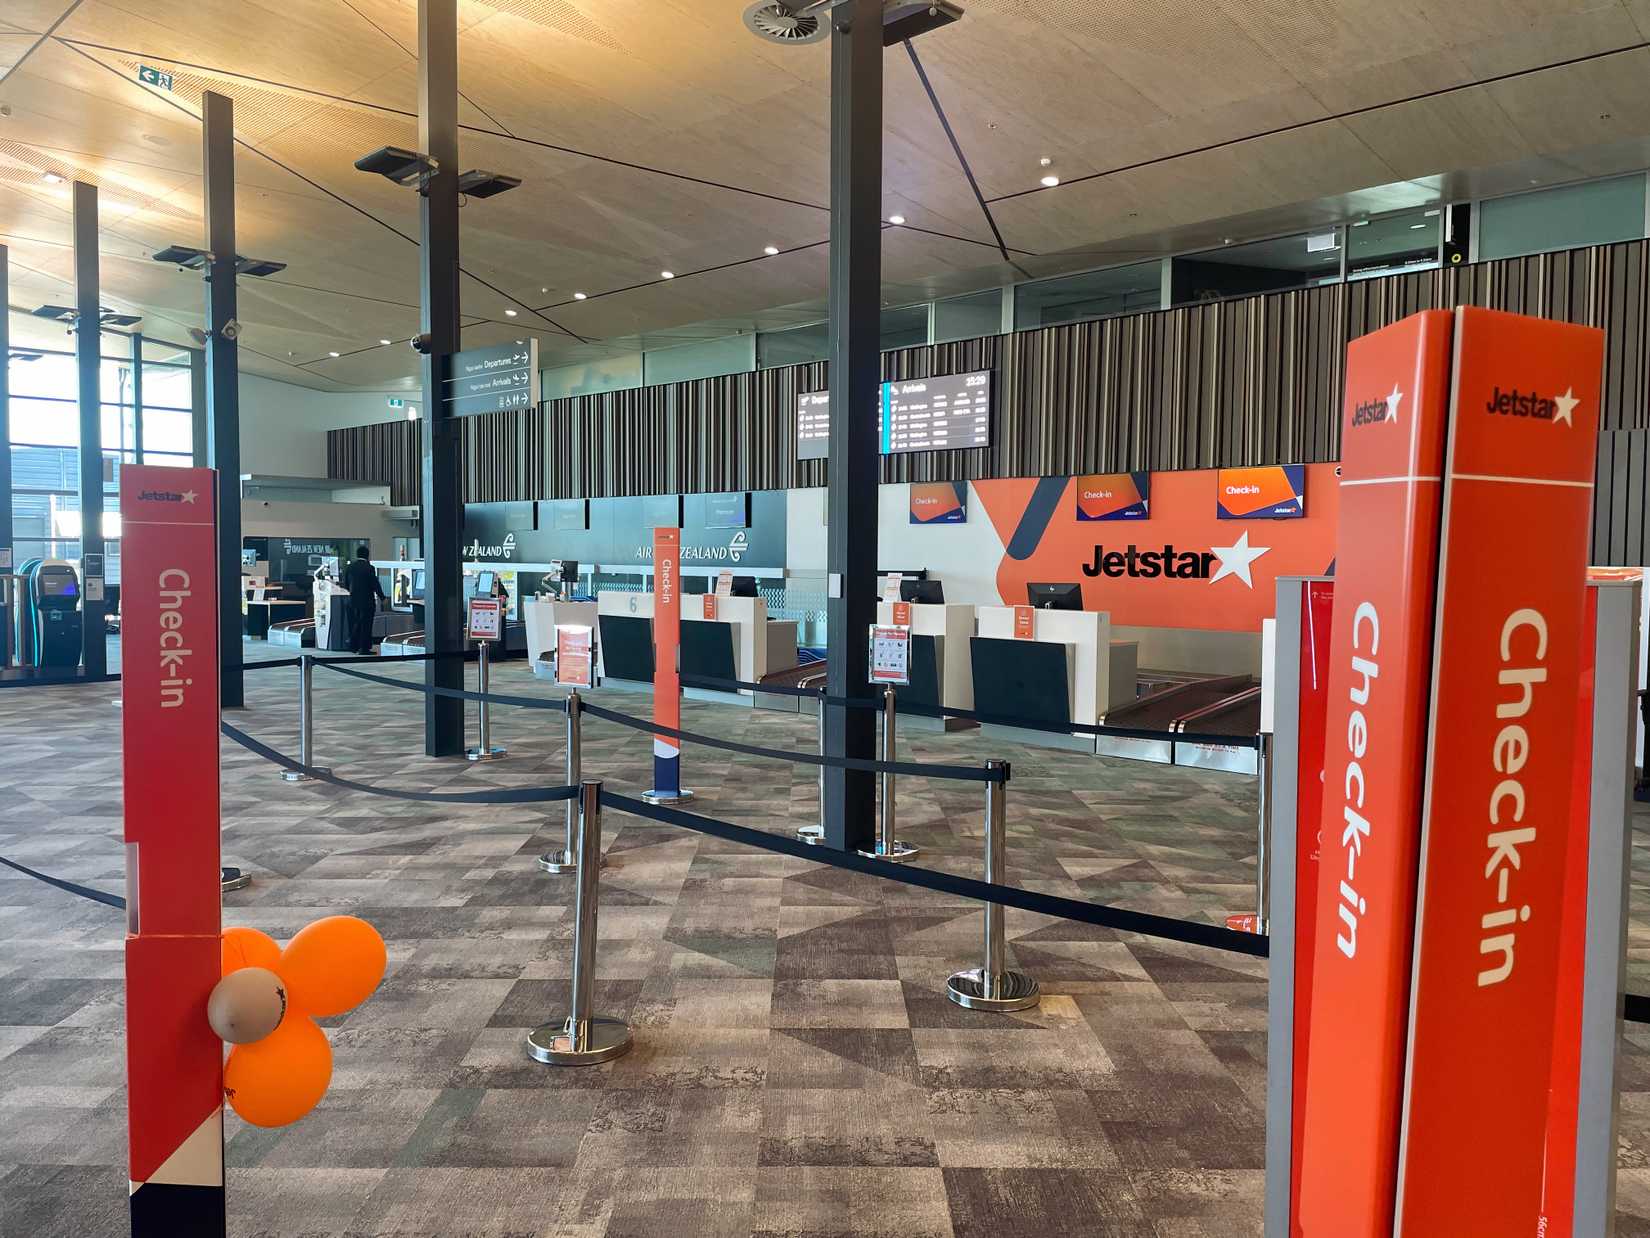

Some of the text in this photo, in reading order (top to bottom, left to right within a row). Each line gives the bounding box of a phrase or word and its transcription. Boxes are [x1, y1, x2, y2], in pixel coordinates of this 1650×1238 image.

[484, 358, 512, 369] Departures
[1351, 397, 1389, 427] Jetstar
[1487, 386, 1557, 420] Jetstar
[137, 490, 184, 502] Jetstar
[1084, 490, 1113, 499] Check-in
[1226, 485, 1260, 495] Check-in
[635, 546, 728, 559] AIR ZEALAND
[1081, 545, 1216, 579] Jetstar
[662, 559, 673, 603] Check-in
[629, 597, 637, 613] 6
[159, 568, 192, 708] Check-in
[1336, 601, 1380, 959] Check-in
[1477, 608, 1548, 987] Check-in
